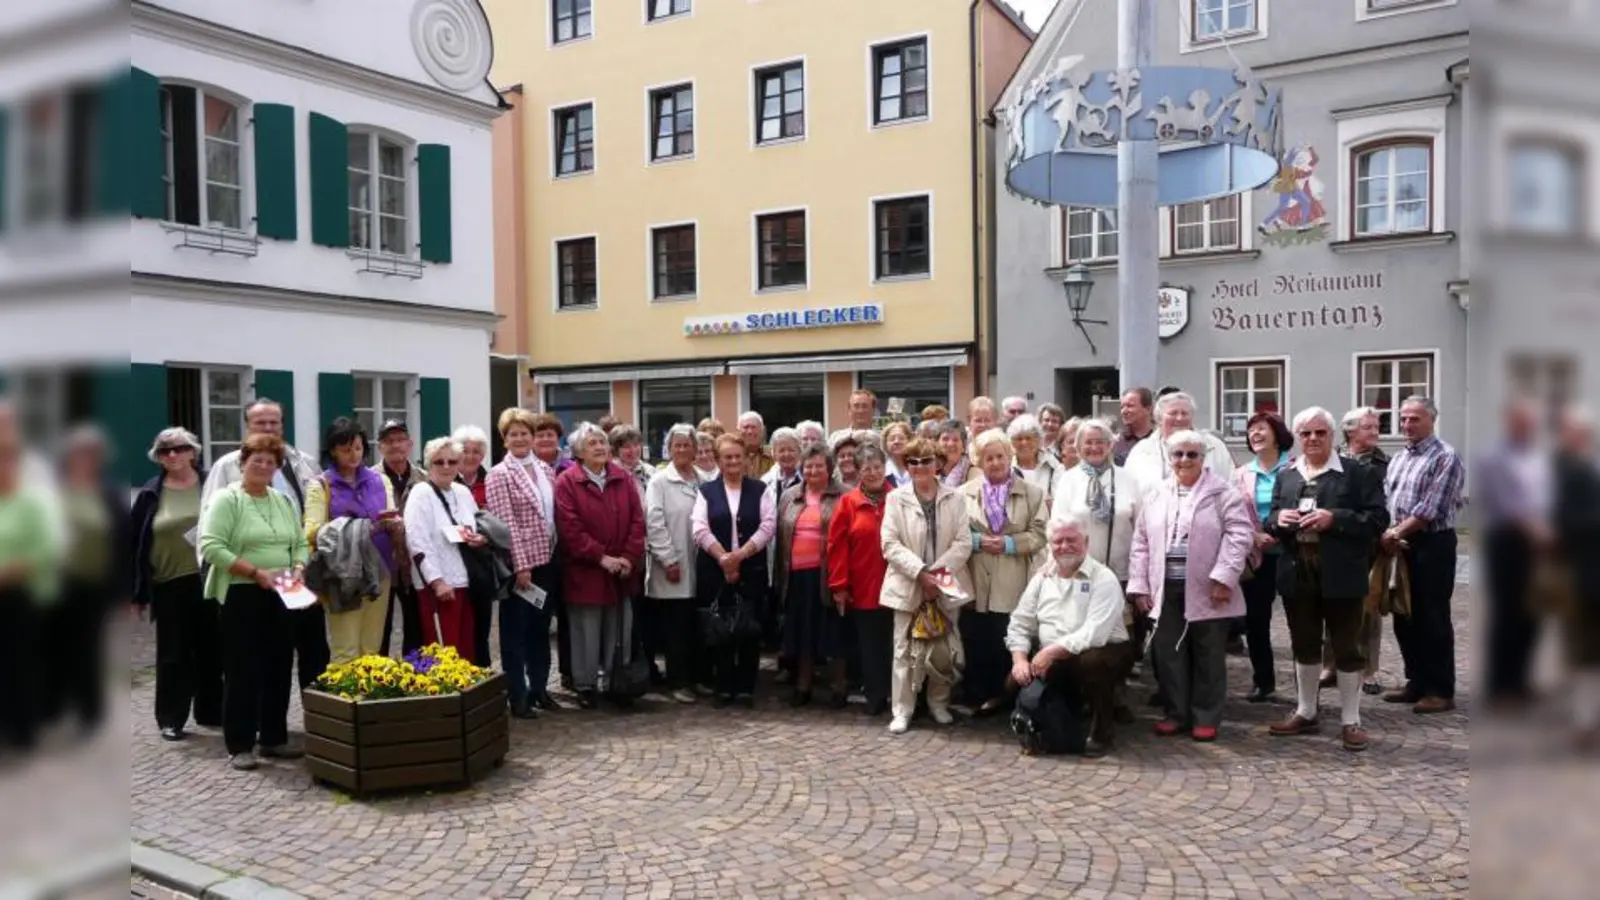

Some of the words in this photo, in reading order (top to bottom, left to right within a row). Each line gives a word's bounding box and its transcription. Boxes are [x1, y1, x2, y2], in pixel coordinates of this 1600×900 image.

[1211, 280, 1258, 299] Hotel
[746, 305, 879, 329] SCHLECKER
[1212, 304, 1383, 331] Bauerntanz
